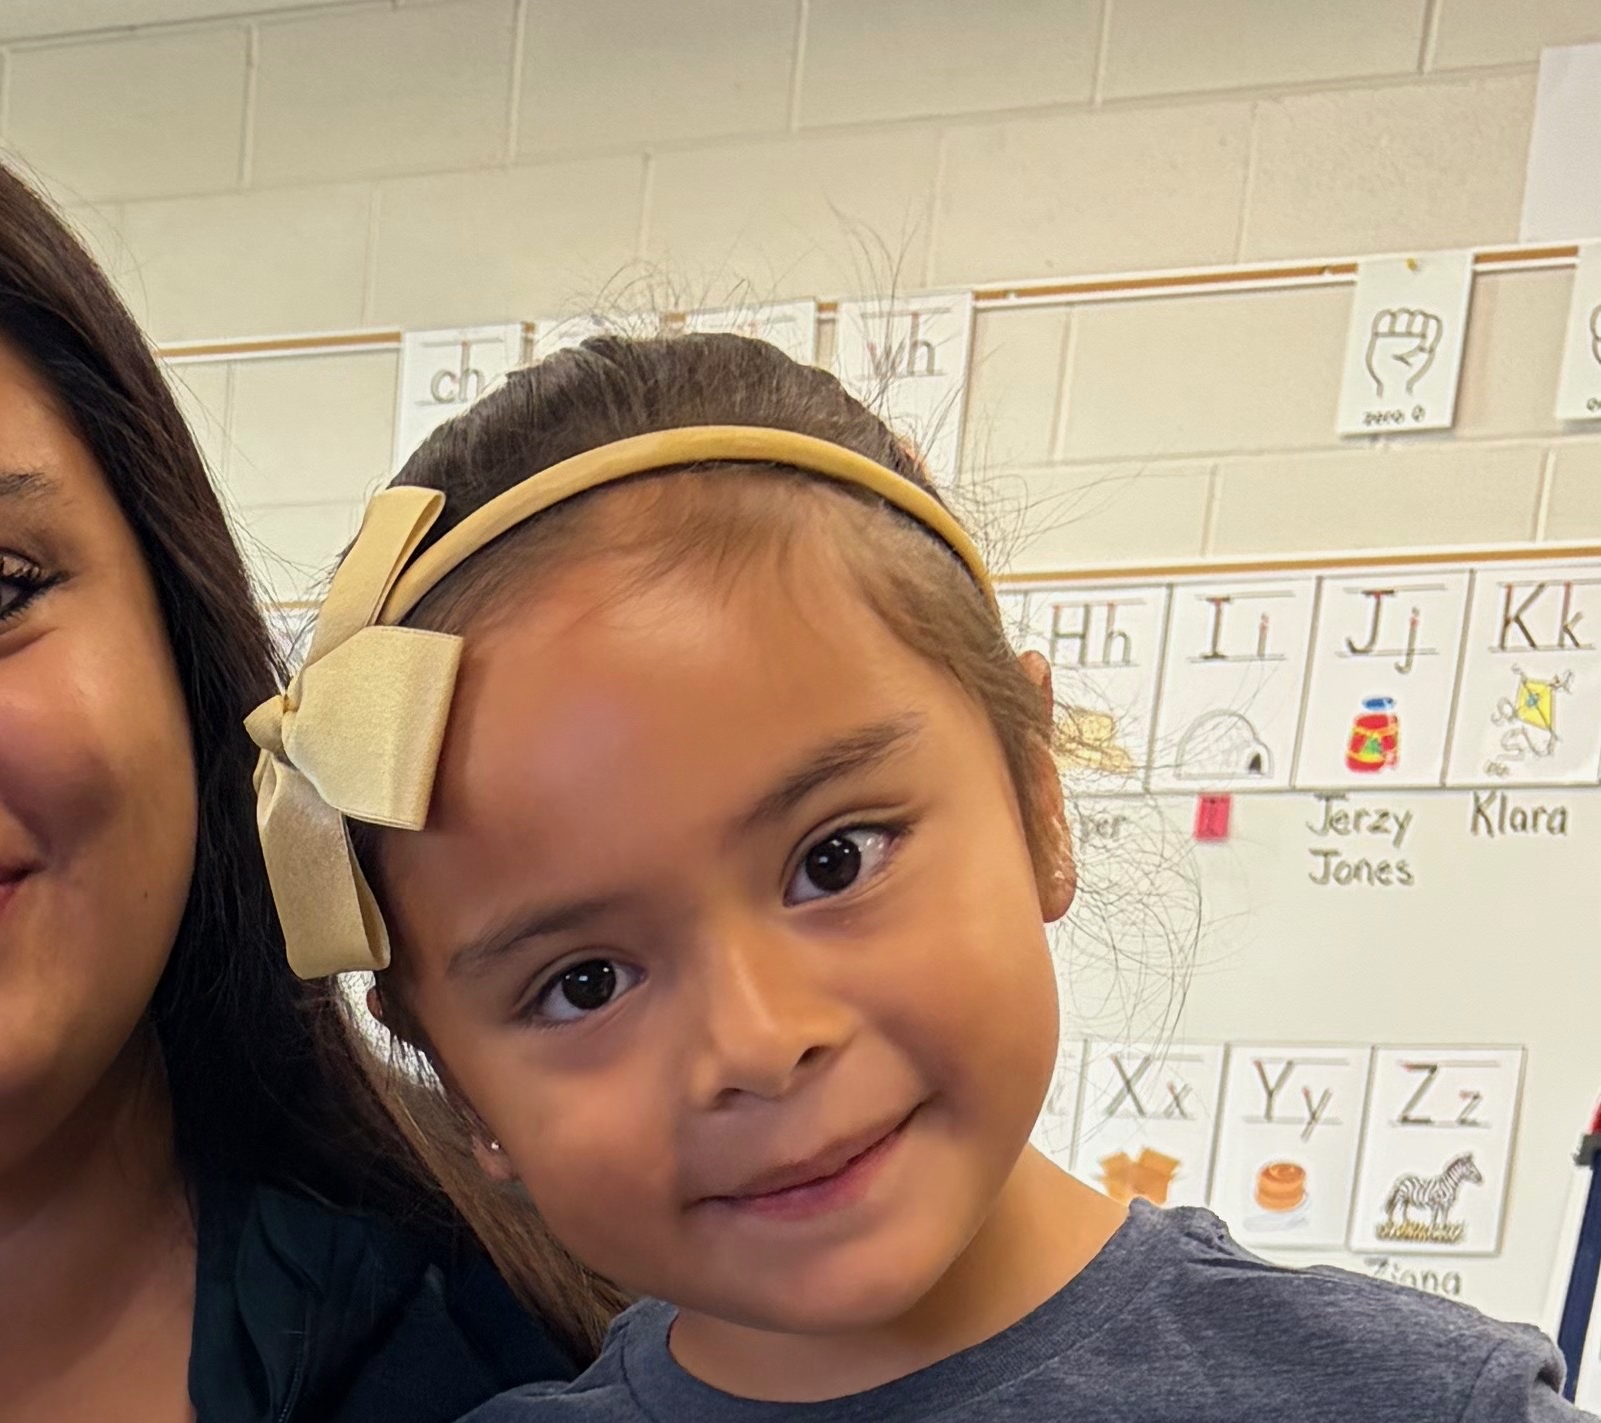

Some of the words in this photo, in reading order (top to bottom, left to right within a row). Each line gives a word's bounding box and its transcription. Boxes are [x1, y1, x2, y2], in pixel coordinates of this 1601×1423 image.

[430, 339, 485, 403] ch
[1305, 793, 1414, 849] Jerzy
[1470, 790, 1569, 838] Klara
[1308, 848, 1416, 887] Jones
